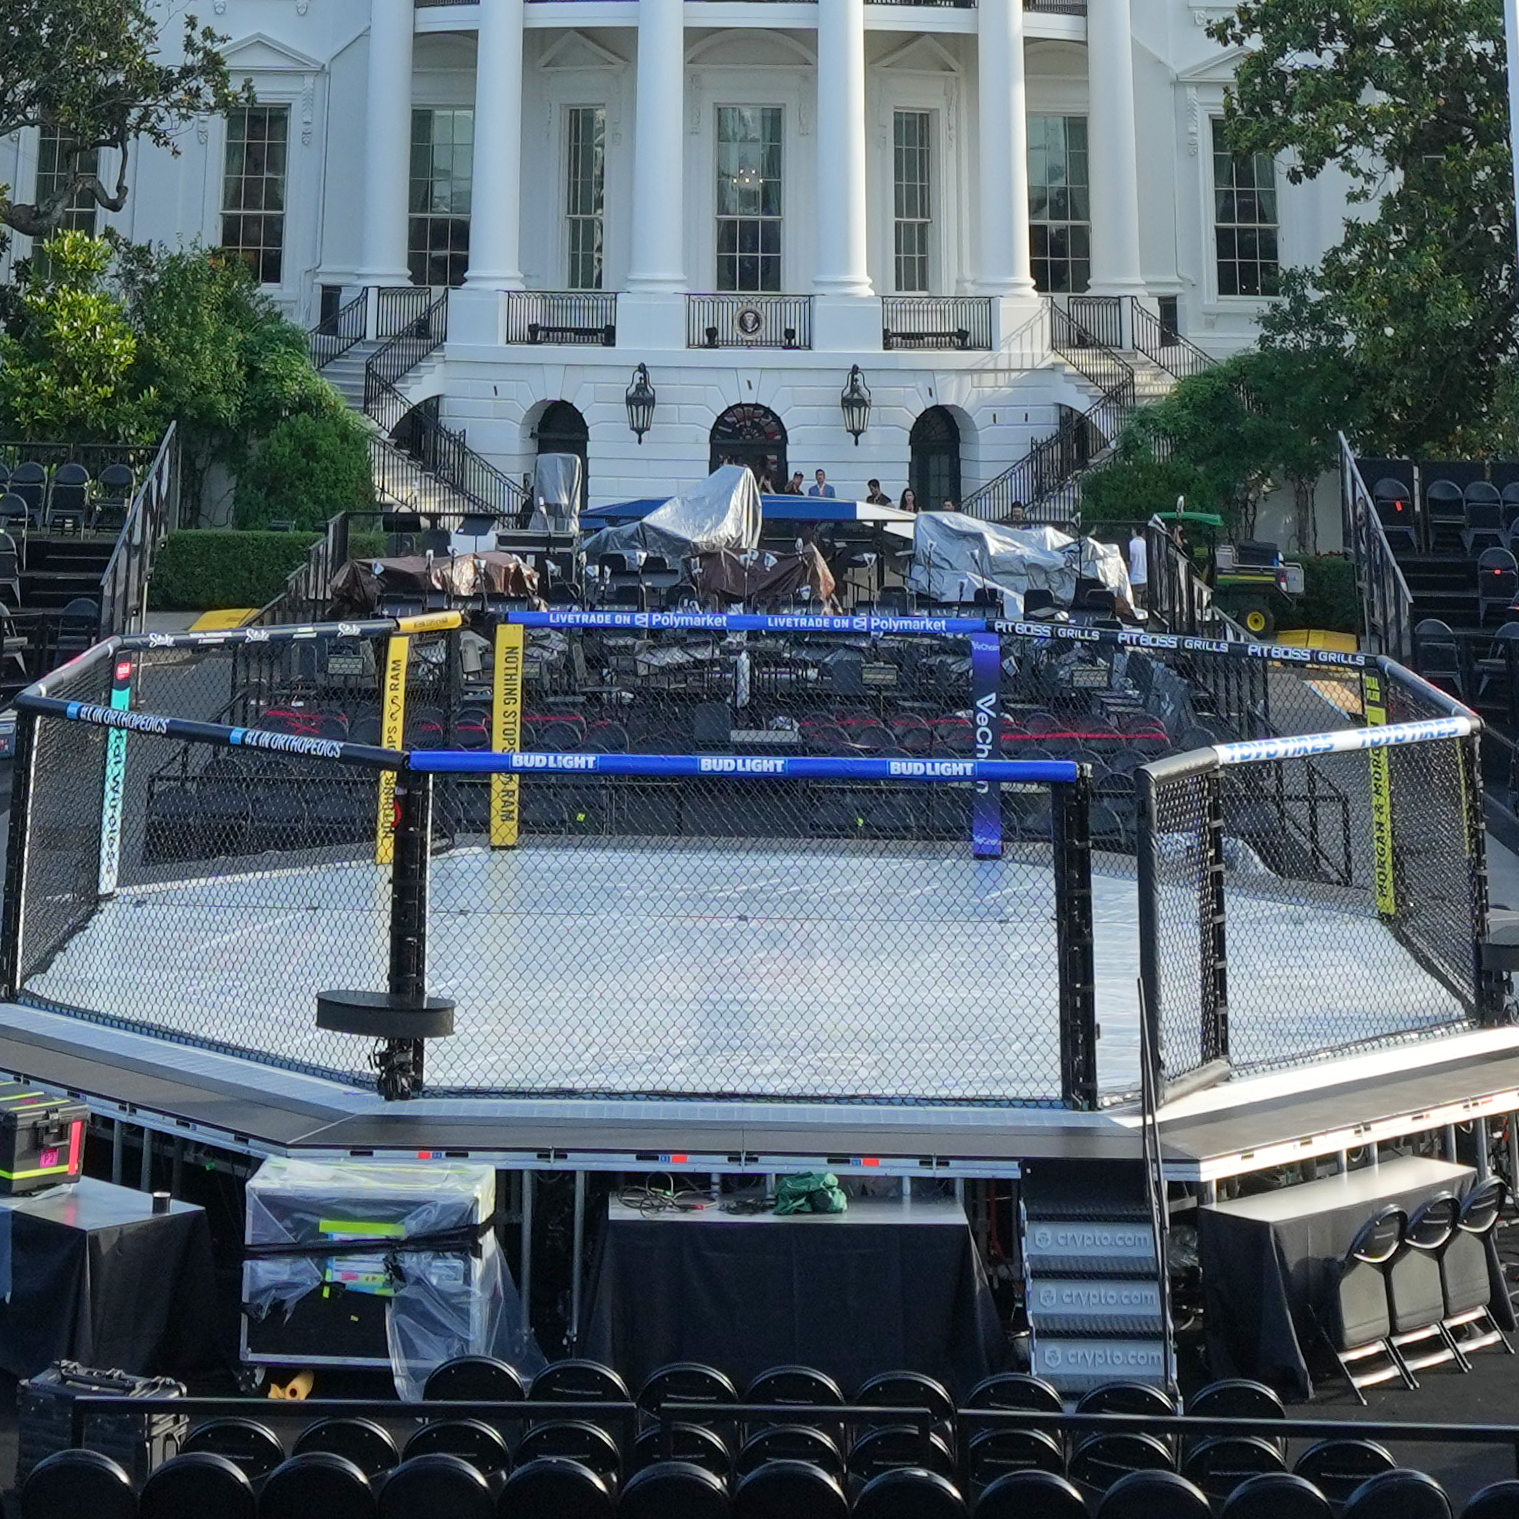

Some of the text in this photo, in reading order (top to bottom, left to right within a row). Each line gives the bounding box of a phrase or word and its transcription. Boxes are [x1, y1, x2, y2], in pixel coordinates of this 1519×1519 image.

[549, 613, 727, 629] LIVETRADE ON Polymarket
[768, 617, 946, 633] LIVETRADE ON Polymarket
[994, 621, 1100, 641] PIT BOSS GRILLS
[1117, 632, 1229, 653] PIT BOSS GRILLS
[1247, 644, 1366, 666] PIT BOSS GRILLS
[389, 659, 402, 692] RAM
[503, 646, 520, 706] NOTHING
[103, 709, 170, 735] ORTHOPEDICS
[976, 692, 997, 793] VeChn
[1357, 719, 1459, 748] TOYO TIRES
[270, 734, 344, 759] ORTHOPEDICS
[1225, 734, 1335, 761] TOYO TIRES
[512, 754, 596, 769] BUD LIGHT
[700, 758, 785, 773] BUD LIGHT
[890, 761, 974, 776] BUD LIGHT
[500, 789, 516, 823] RAM
[1375, 820, 1388, 898] MORGAN
[1057, 1231, 1150, 1248] crypto.com
[1062, 1288, 1157, 1307] crypto.com
[1067, 1346, 1163, 1367] crypto.com
